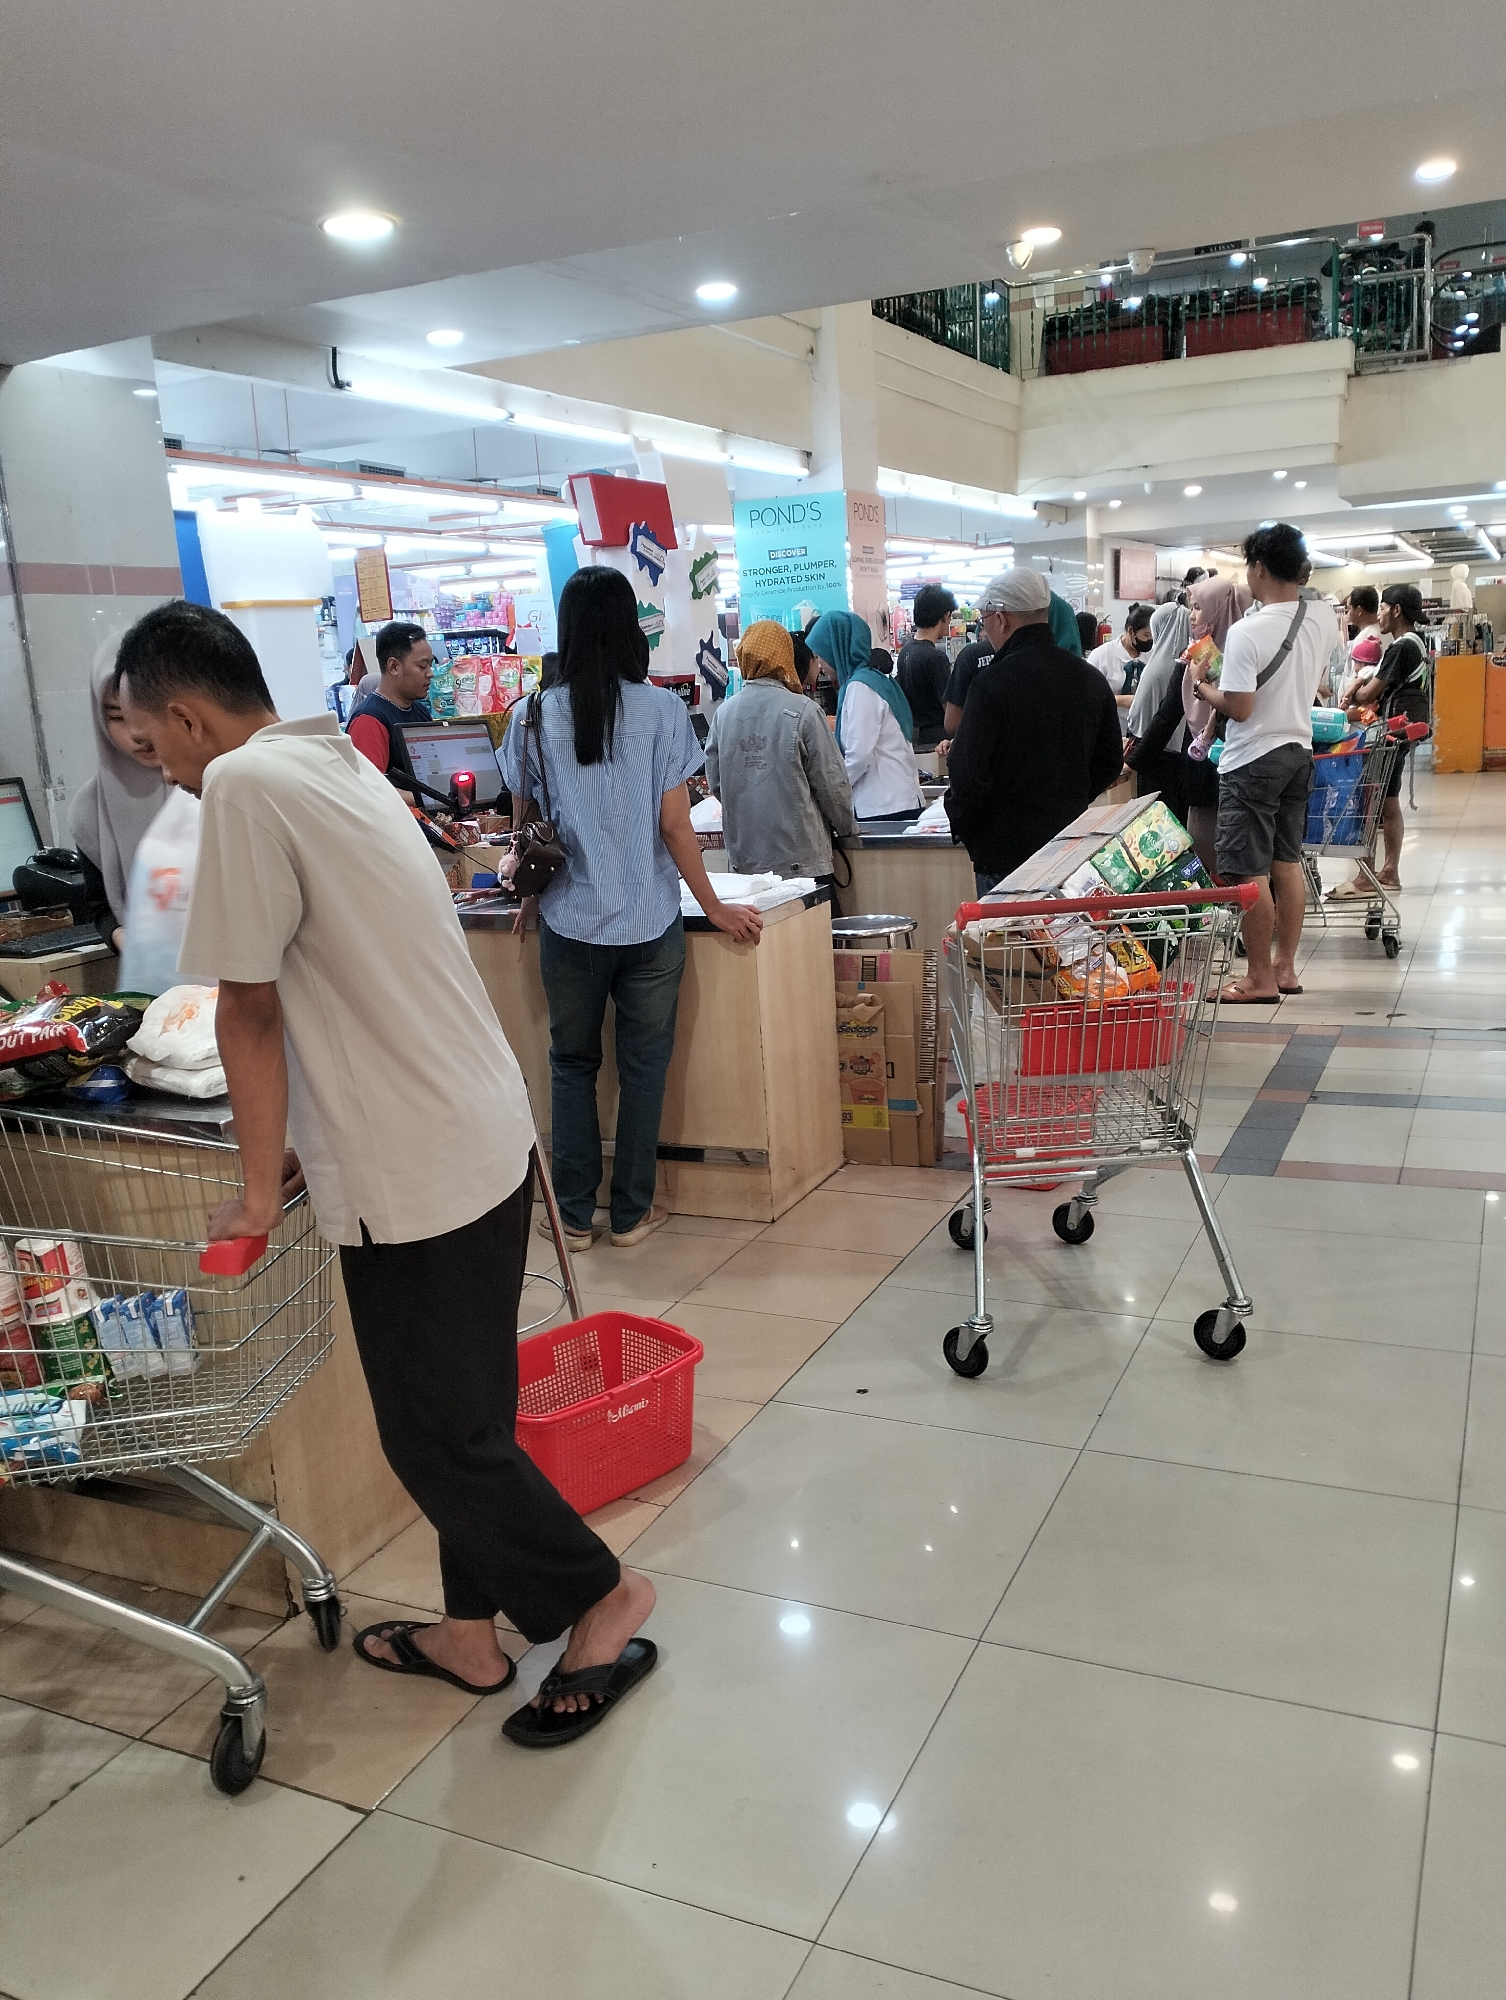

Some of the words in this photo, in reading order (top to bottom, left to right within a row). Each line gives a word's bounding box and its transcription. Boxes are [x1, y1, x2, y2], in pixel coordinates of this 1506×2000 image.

[749, 501, 822, 528] POND'S
[770, 548, 806, 559] DISCOVER
[742, 565, 792, 577] STRONGER,
[793, 559, 837, 572] PLUMPER,
[755, 575, 803, 587] HYDRATED
[804, 573, 826, 582] SKIN
[761, 588, 786, 596] Ceramide
[787, 585, 817, 593] Production
[31, 1025, 68, 1043] PACK
[838, 1024, 878, 1036] Sedaap
[842, 1112, 852, 1121] 93
